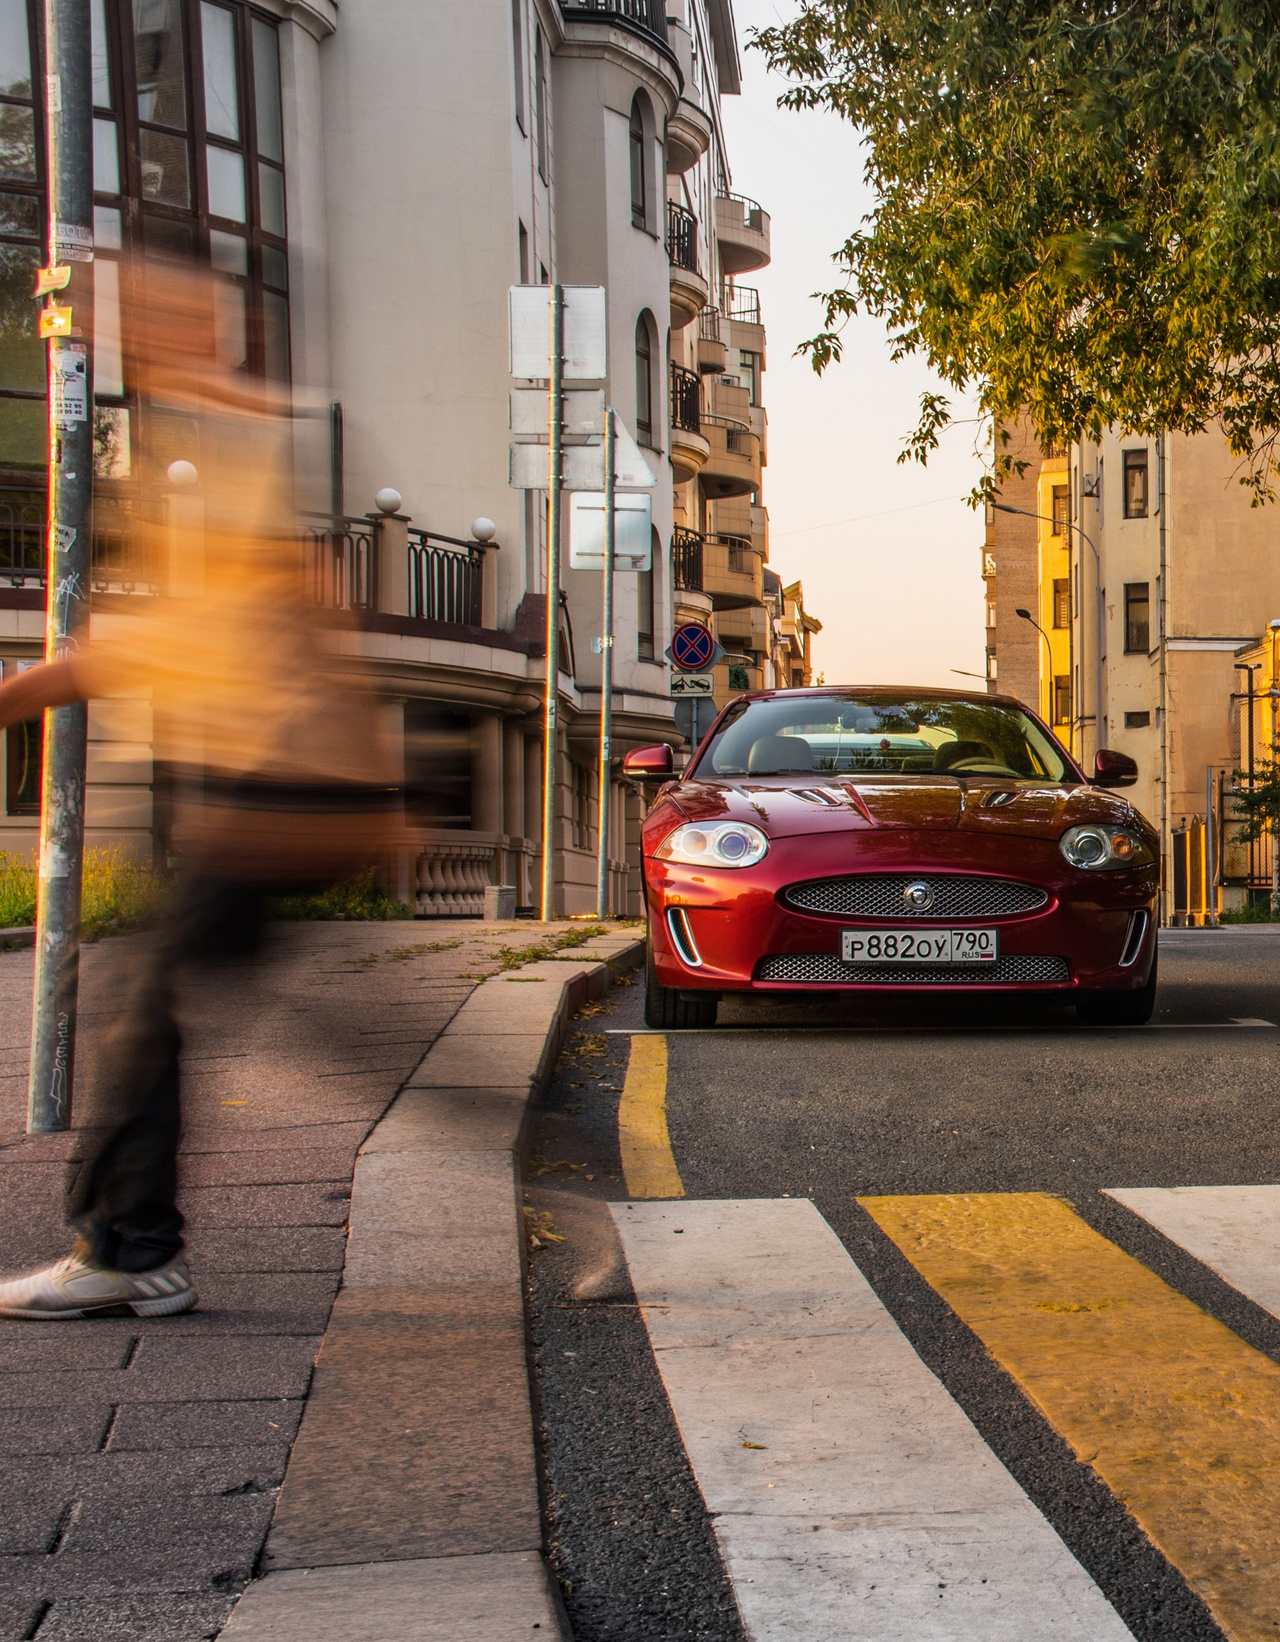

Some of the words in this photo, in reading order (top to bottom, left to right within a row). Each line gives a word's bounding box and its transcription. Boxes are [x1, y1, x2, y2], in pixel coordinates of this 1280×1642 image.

[850, 934, 947, 959] Р882ОУ
[953, 932, 990, 951] 790
[961, 951, 980, 959] RUS
